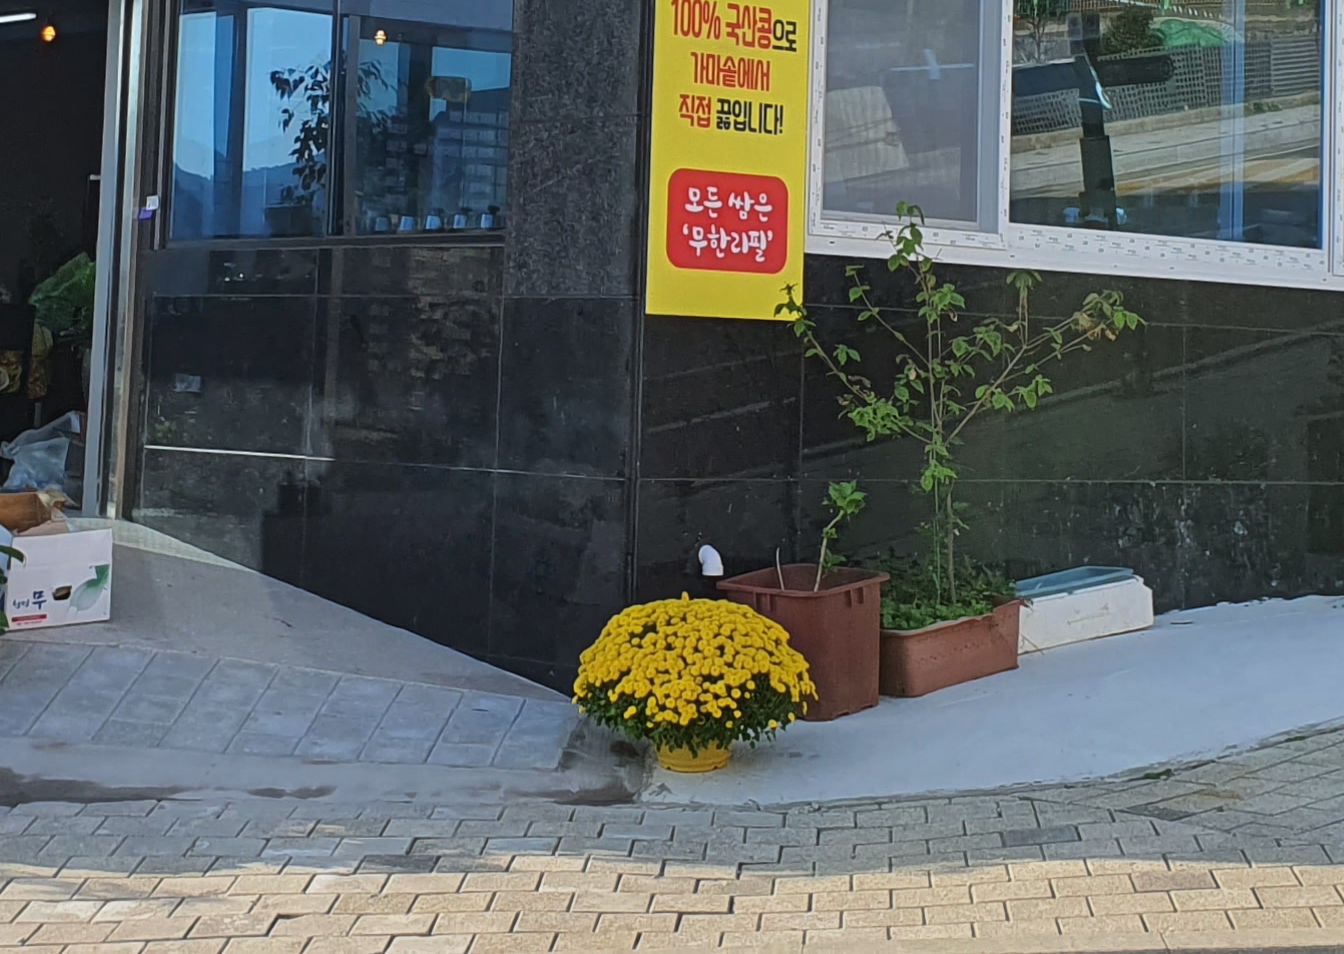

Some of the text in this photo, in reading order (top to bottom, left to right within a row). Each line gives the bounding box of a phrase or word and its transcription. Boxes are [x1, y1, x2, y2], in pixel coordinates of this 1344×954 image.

[726, 3, 797, 52] 국산콩으로
[690, 51, 770, 92] 가마솥에서
[678, 94, 783, 135] 직접 끓입니다!
[685, 186, 773, 222] 모든 쌈은
